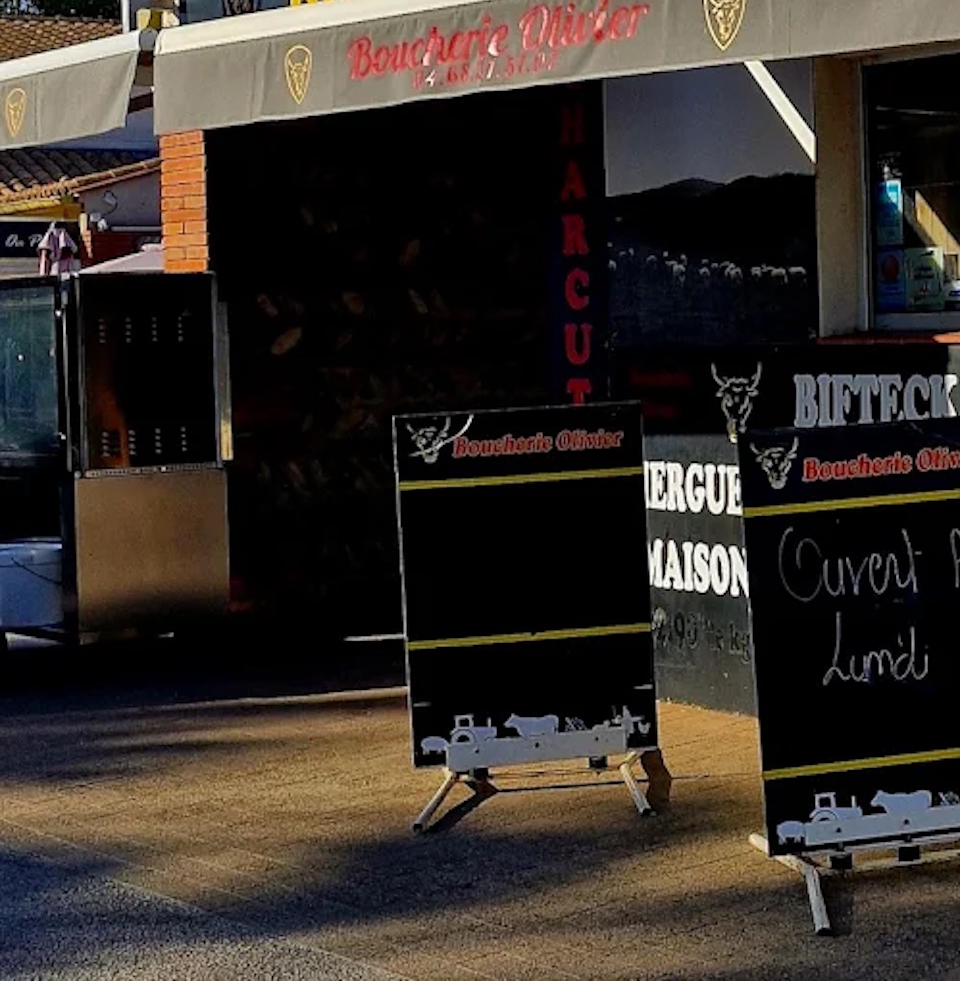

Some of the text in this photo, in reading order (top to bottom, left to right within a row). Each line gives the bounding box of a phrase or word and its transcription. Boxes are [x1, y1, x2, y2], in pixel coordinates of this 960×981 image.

[348, 23, 508, 81] Boucherie
[560, 81, 594, 406] HARCUT
[793, 373, 958, 428] BIFTECK
[453, 428, 624, 459] Boucherie Olivier
[802, 451, 912, 482] Boucherie
[778, 526, 922, 602] Ouvert
